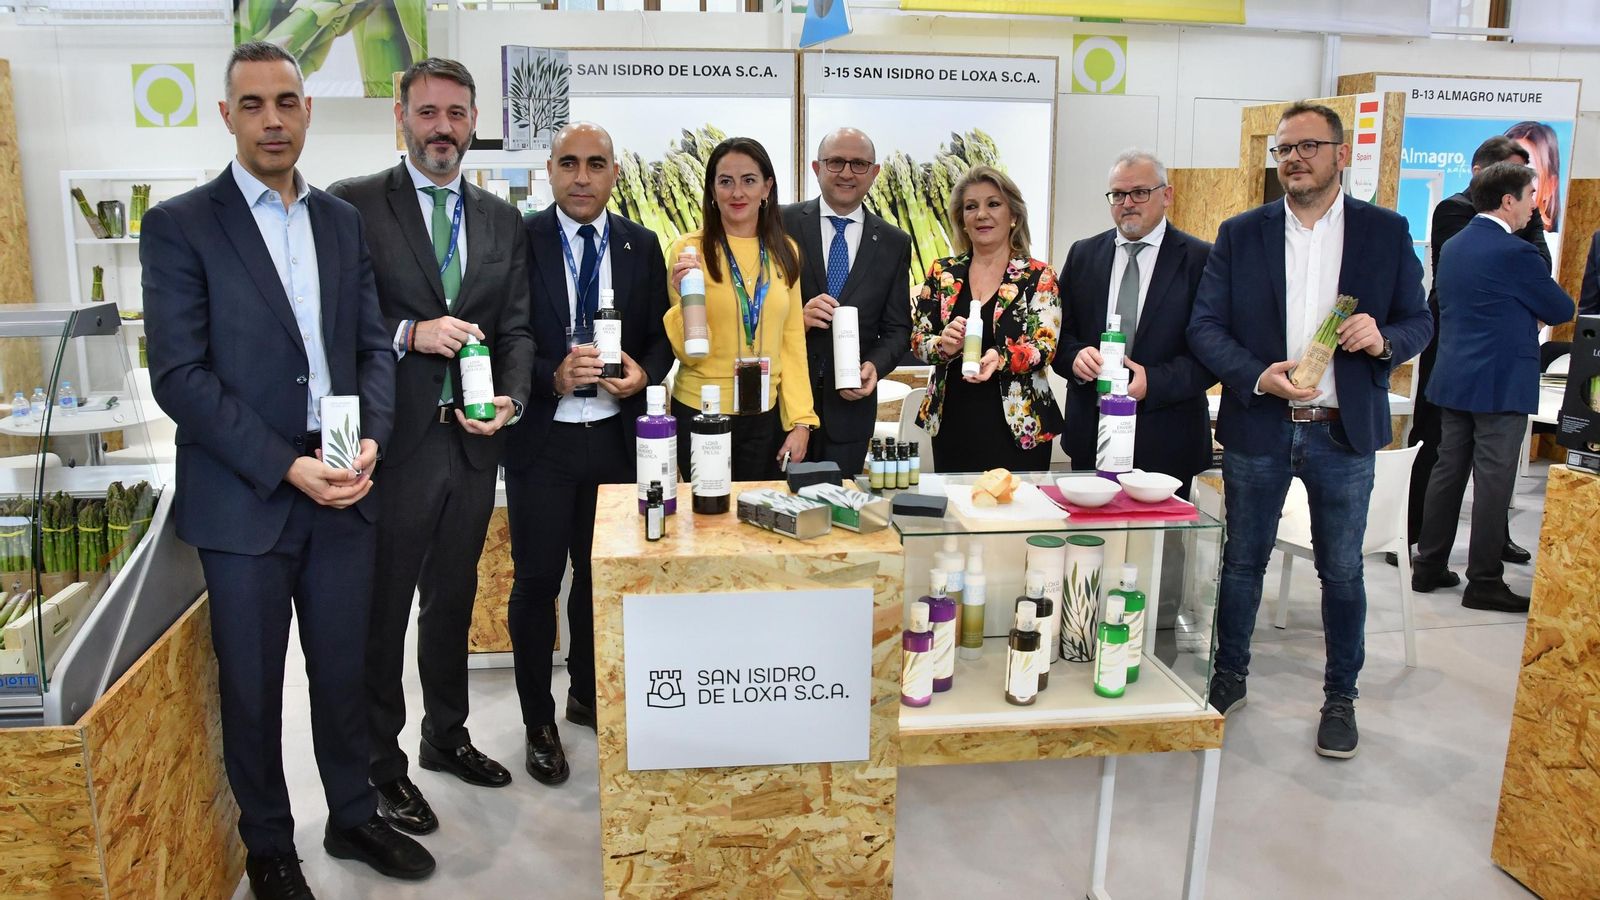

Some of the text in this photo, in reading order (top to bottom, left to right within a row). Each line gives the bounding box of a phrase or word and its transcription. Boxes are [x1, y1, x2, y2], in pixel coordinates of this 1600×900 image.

[577, 63, 608, 76] SAN
[612, 64, 664, 76] ISIDRO
[669, 65, 689, 76] DE
[693, 65, 732, 77] LOXA
[736, 66, 778, 78] S.C.A.
[853, 67, 883, 79] SAN
[887, 68, 935, 80] ISIDRO
[939, 69, 958, 81] DE
[961, 70, 998, 82] LOXA
[1001, 71, 1041, 83] S.C.A.
[1411, 89, 1543, 103] B-13 ALMAGRO NATURE
[1356, 153, 1372, 162] Spain
[697, 665, 817, 686] SAN ISIDRO
[698, 683, 850, 705] DE LOXA S.C.A.
